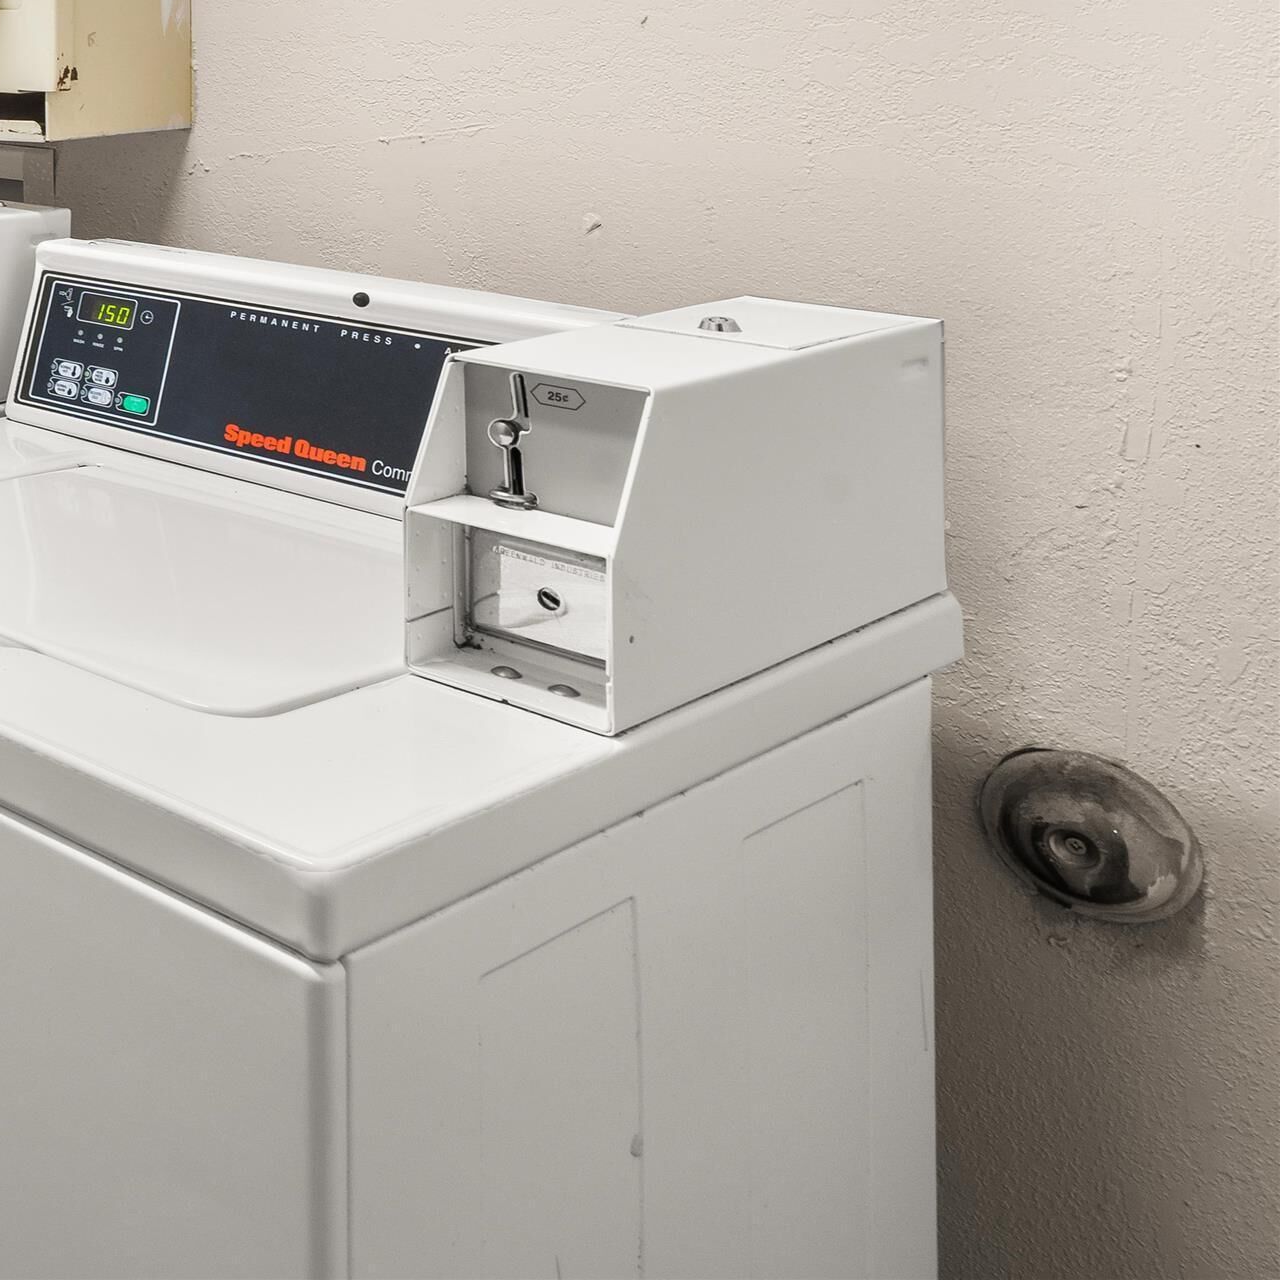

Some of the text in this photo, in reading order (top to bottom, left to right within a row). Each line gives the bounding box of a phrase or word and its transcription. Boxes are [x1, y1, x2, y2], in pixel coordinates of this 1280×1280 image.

[97, 303, 131, 325] 150
[230, 310, 321, 334] PERMANENT
[340, 329, 393, 346] PRESS
[224, 422, 292, 455] Speed
[293, 438, 368, 472] Queen
[492, 544, 606, 582] GREENWALD INDUSTRIES
